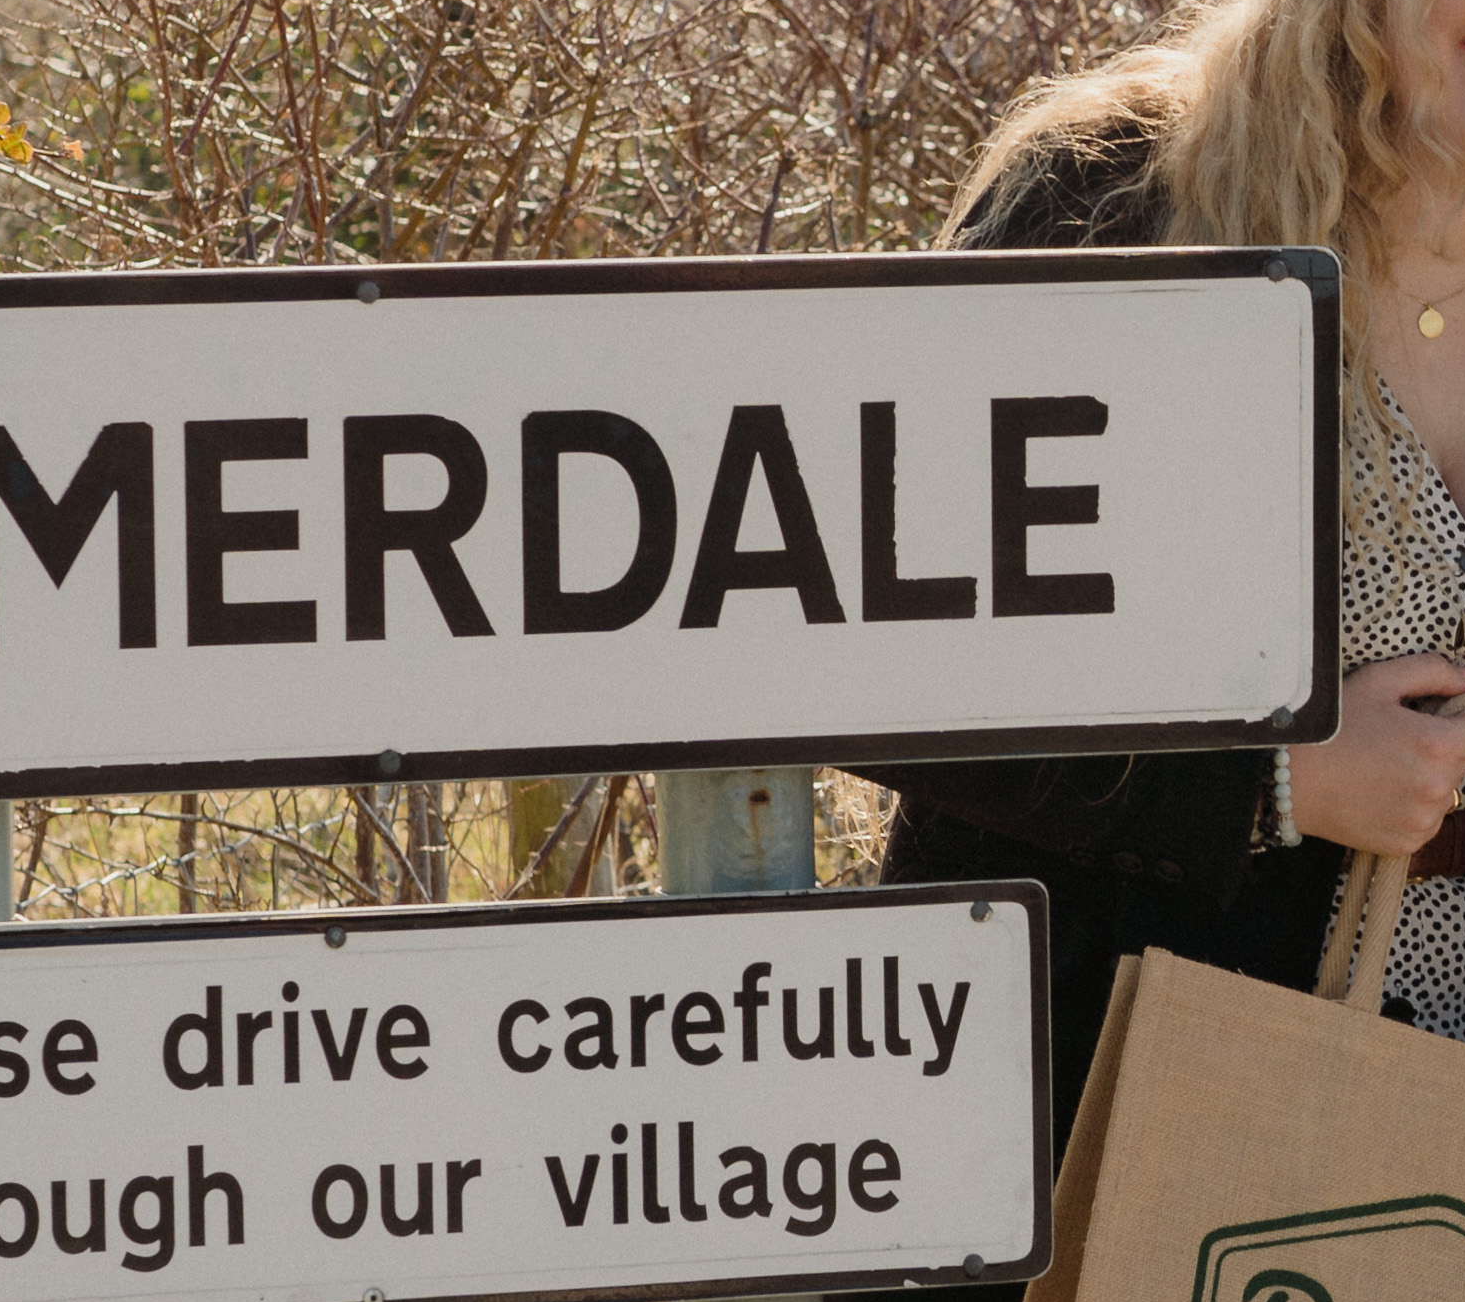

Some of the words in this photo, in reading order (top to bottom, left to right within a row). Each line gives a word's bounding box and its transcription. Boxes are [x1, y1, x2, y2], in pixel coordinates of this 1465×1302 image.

[163, 981, 430, 1090] drive
[498, 956, 970, 1076] carefully
[312, 1159, 481, 1239] our
[543, 1121, 901, 1236] village
